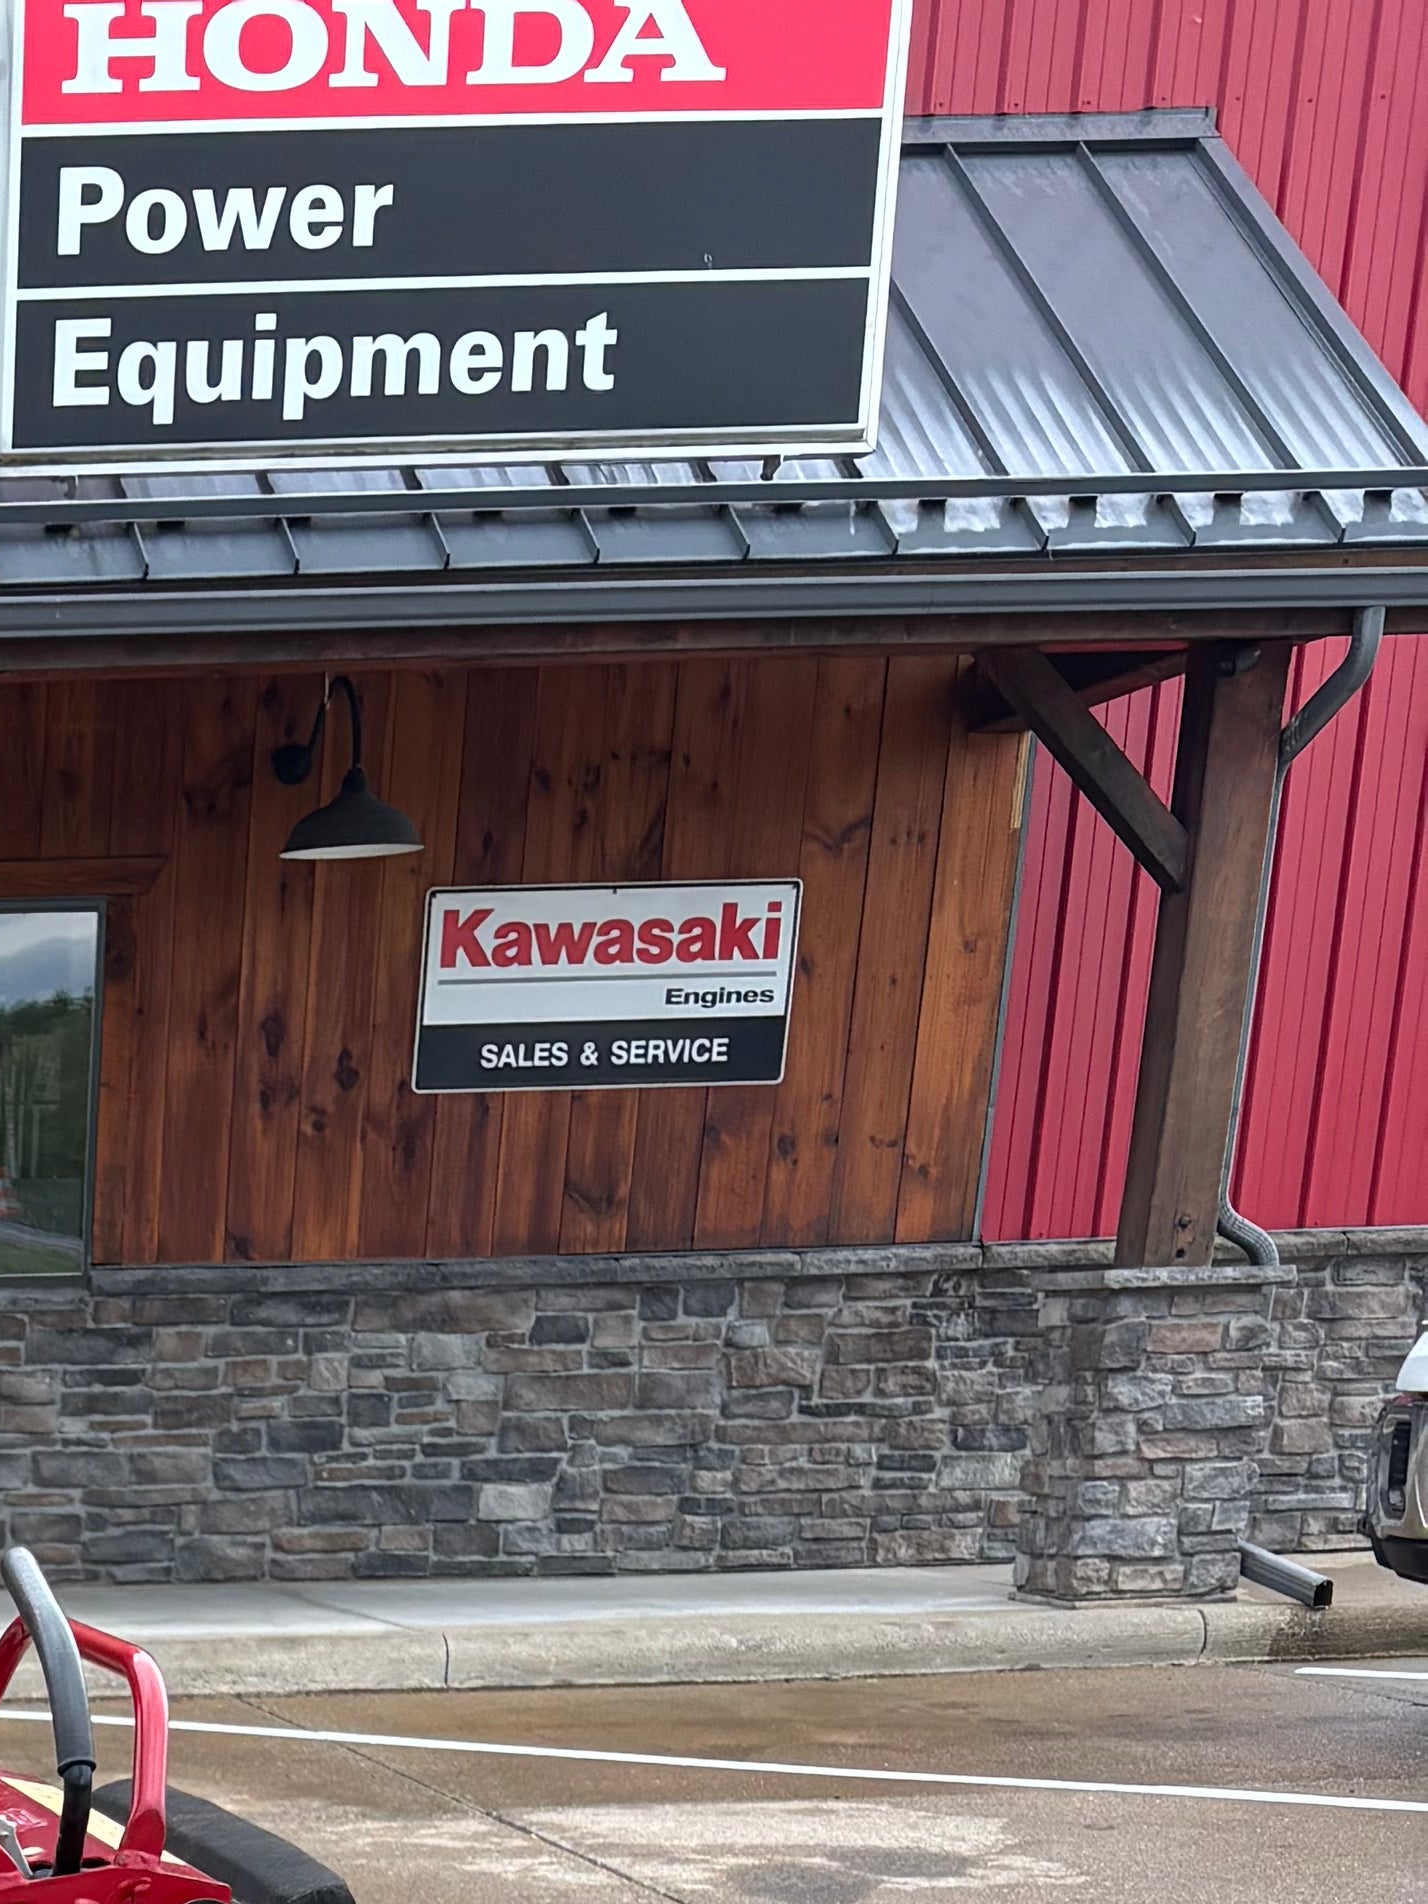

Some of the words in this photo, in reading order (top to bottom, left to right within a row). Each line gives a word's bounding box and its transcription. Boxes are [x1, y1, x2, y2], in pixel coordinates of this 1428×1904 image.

[61, 0, 726, 95] HONDA
[56, 166, 395, 257] Power
[51, 311, 618, 427] Equipment
[439, 901, 783, 969] Kawasaki
[664, 986, 776, 1009] Engines
[480, 1042, 570, 1069] SALES
[579, 1041, 599, 1067] &
[610, 1037, 730, 1065] SERVICE
